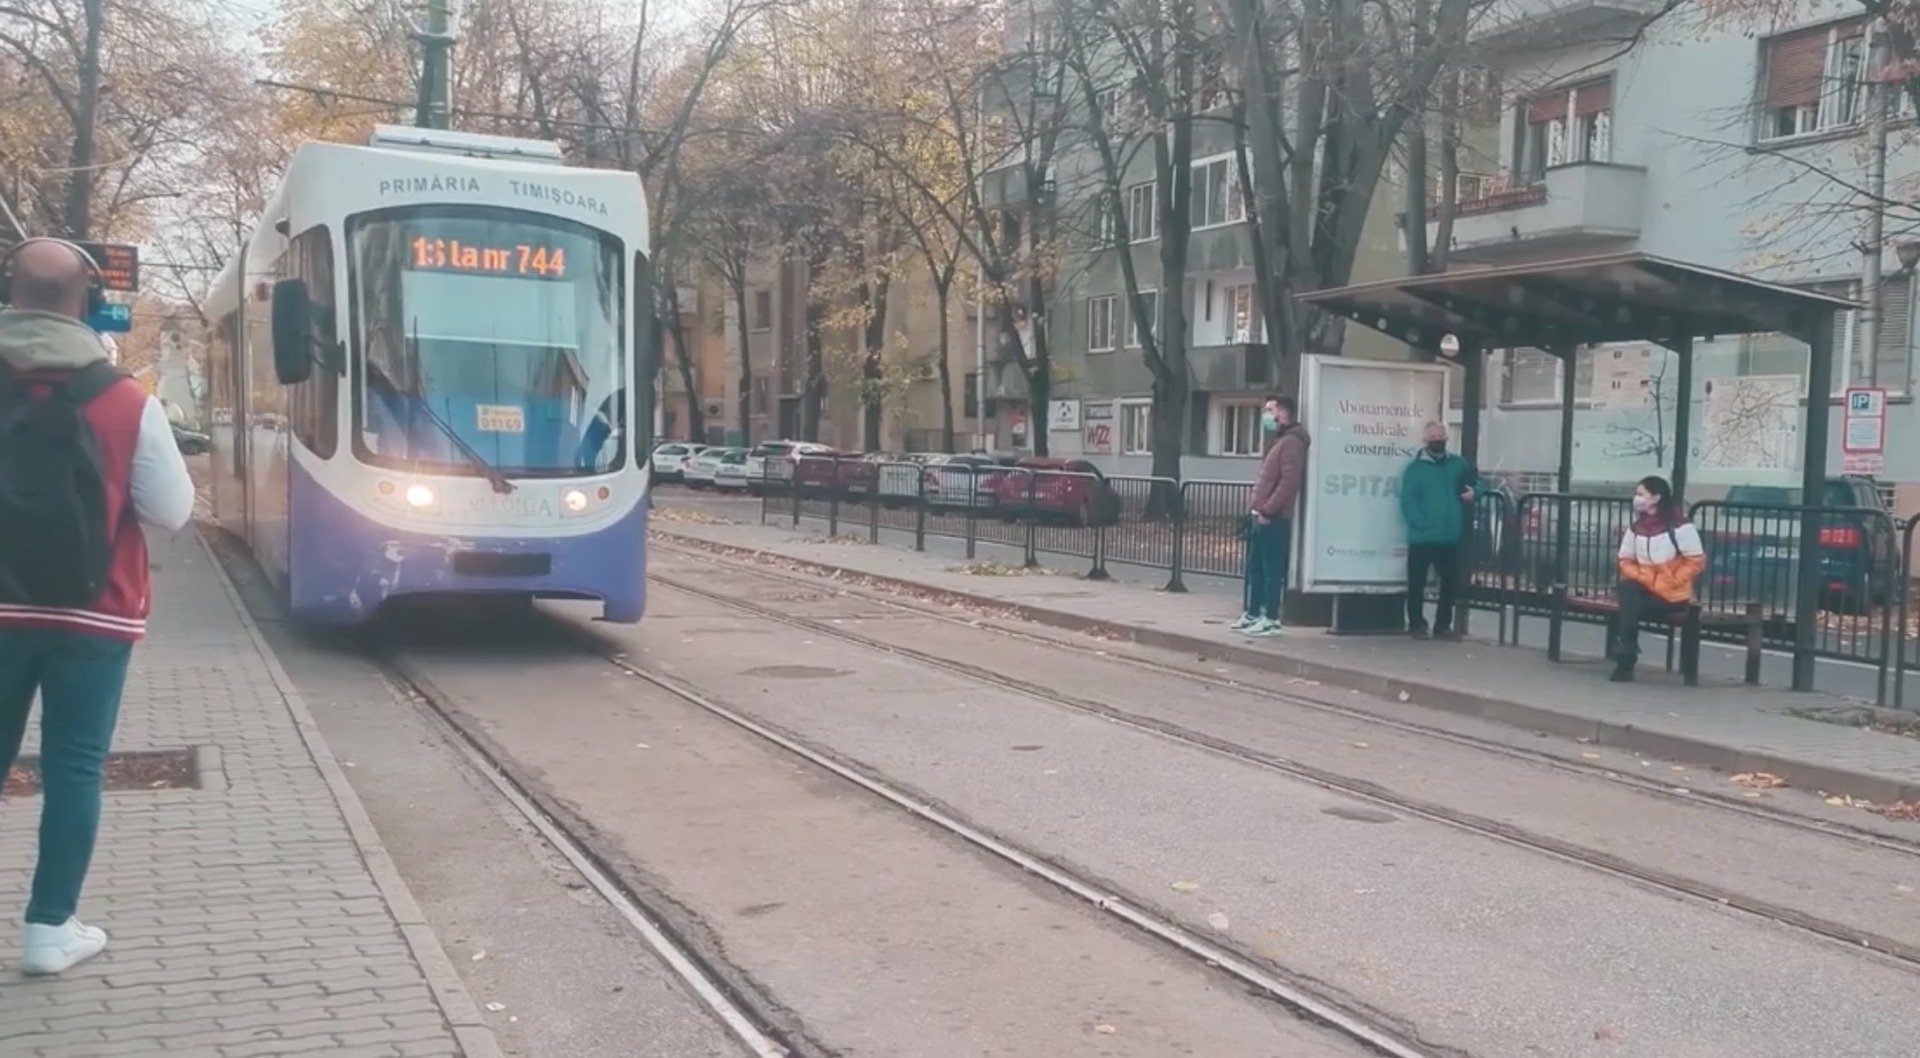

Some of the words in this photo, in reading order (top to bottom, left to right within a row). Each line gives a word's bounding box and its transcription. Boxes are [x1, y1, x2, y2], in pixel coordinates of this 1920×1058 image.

[515, 244, 567, 277] 744
[1338, 400, 1425, 418] Abonamentele
[1353, 421, 1409, 437] medicale
[1324, 473, 1401, 498] SPITA
